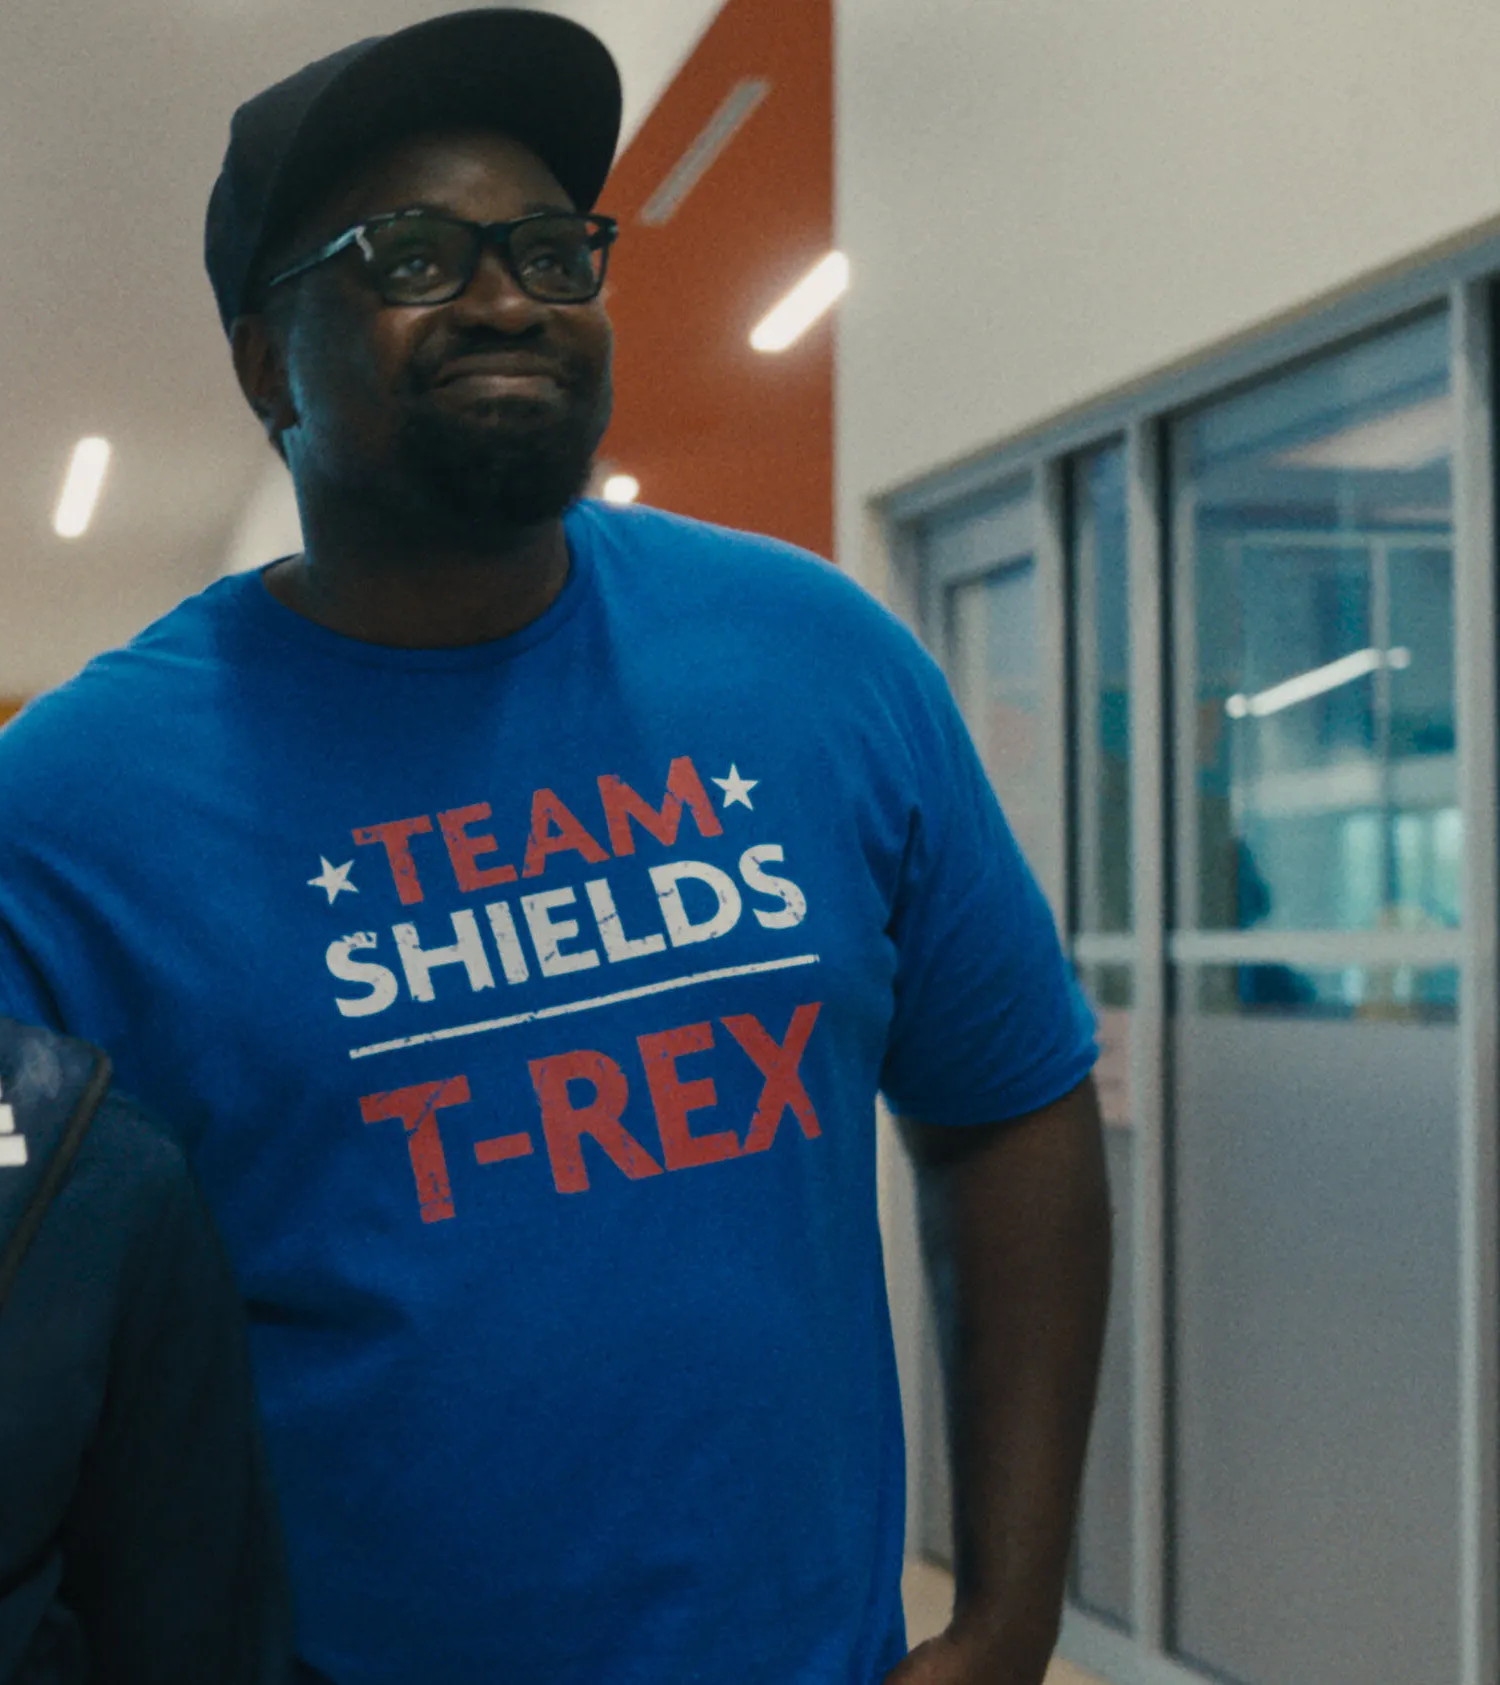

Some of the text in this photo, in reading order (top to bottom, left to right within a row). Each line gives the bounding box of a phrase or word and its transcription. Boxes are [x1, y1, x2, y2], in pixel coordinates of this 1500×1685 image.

[351, 755, 724, 905] TEAM
[325, 844, 807, 1017] SHIELDS
[359, 1001, 823, 1224] T-REX
